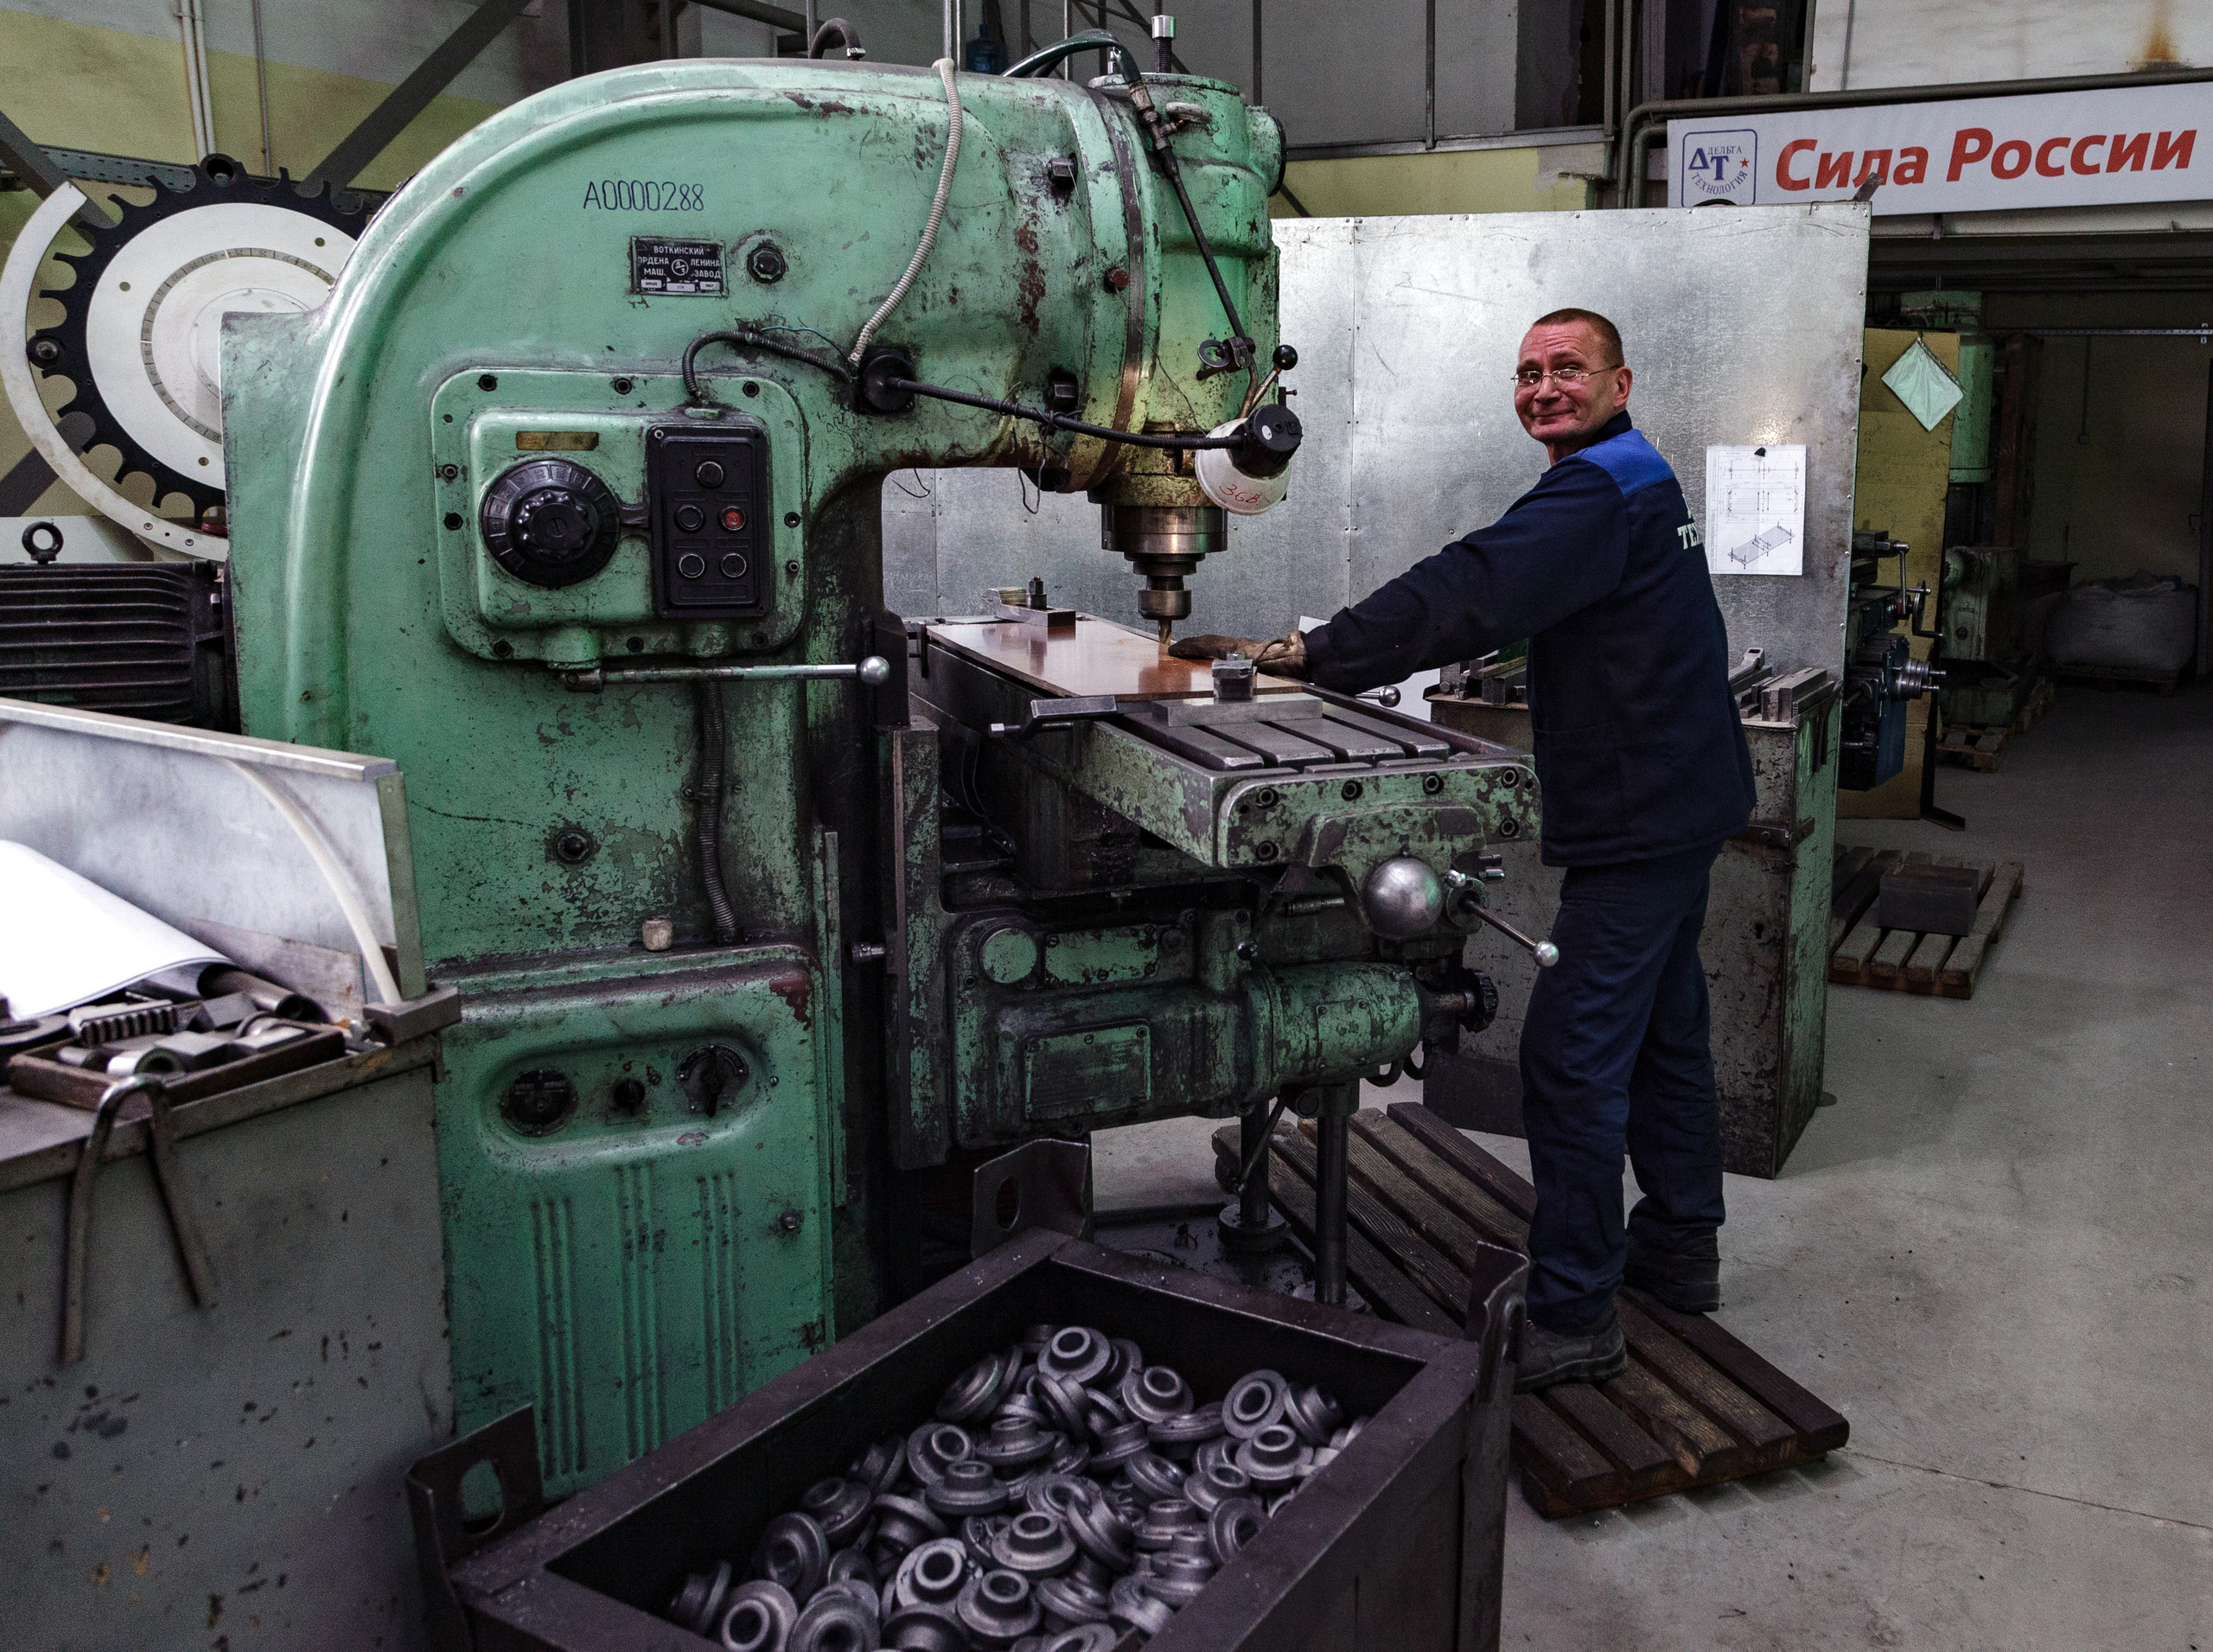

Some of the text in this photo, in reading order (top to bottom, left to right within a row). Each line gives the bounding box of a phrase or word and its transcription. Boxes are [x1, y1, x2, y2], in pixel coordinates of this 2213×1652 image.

[1707, 145, 1743, 156] ДЕЛЬТА
[1776, 127, 2197, 191] Сила России
[1692, 170, 1748, 195] ТЕХНОЛОГИЯ
[654, 245, 705, 256] ВОТКИНСКИЙ
[637, 256, 720, 267] ОРДЕНА ЛЕНИНА
[694, 270, 721, 279] ЗАВОД
